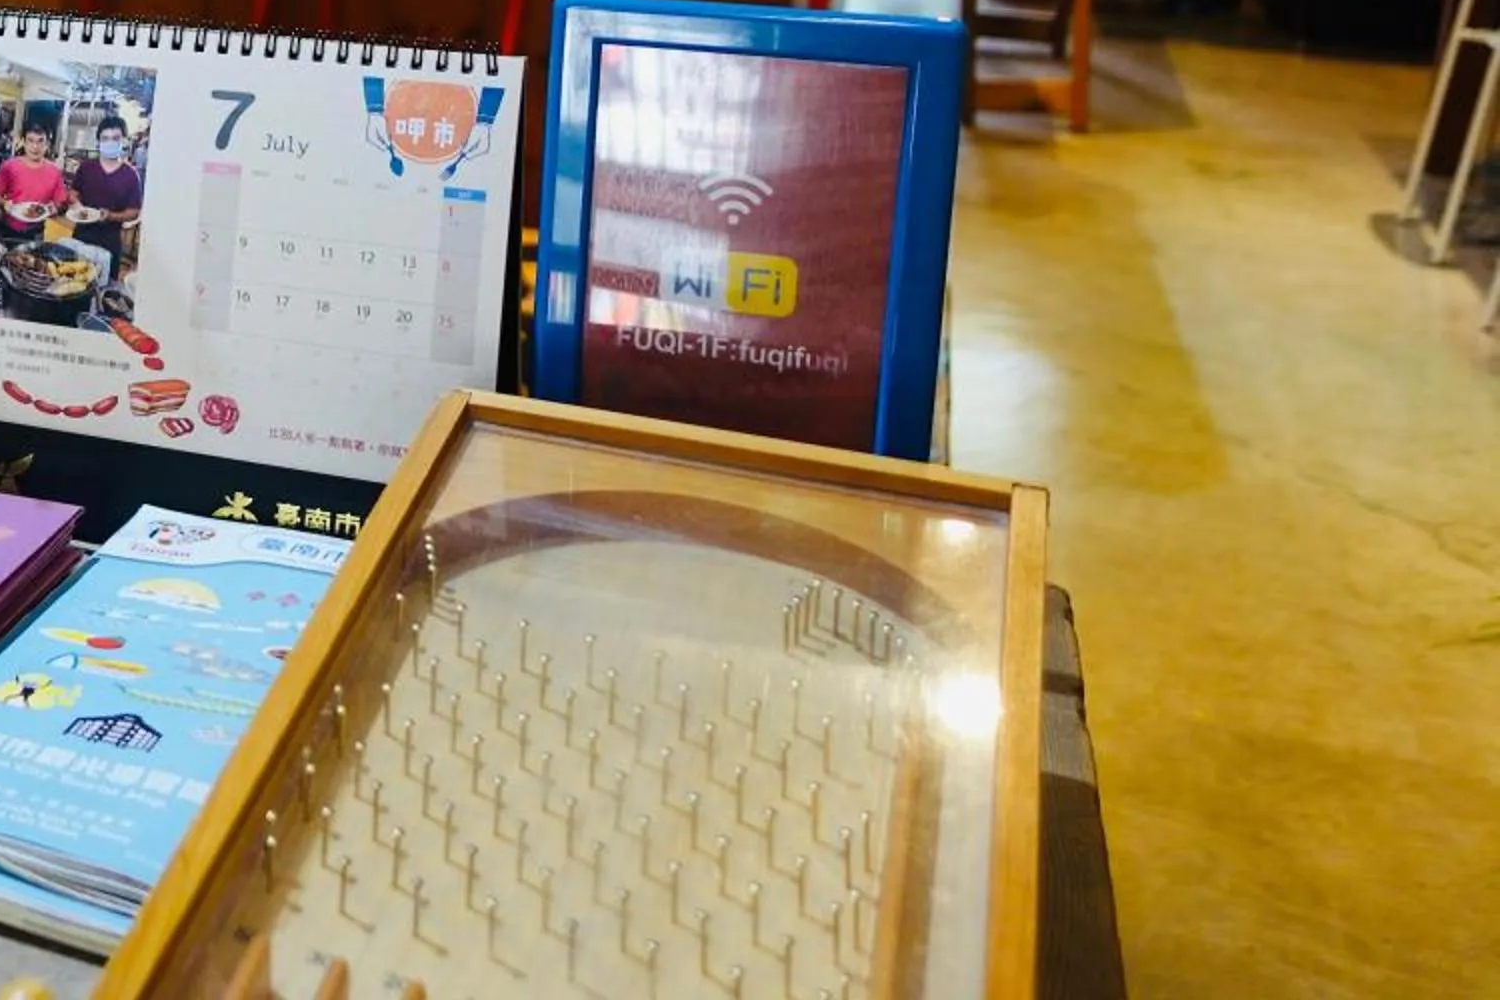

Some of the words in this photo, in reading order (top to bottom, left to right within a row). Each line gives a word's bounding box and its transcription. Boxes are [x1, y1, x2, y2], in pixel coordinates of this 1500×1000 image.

[211, 90, 256, 150] 7
[395, 117, 455, 148] 呷市
[261, 133, 310, 160] July
[238, 236, 248, 249] 9
[279, 240, 295, 255] 10
[320, 246, 333, 260] 11
[360, 250, 375, 265] 12
[402, 255, 417, 270] 13
[236, 288, 250, 303] 16
[276, 294, 290, 308] 17
[316, 299, 330, 314] 18
[356, 304, 371, 319] 19
[396, 309, 413, 324] 20
